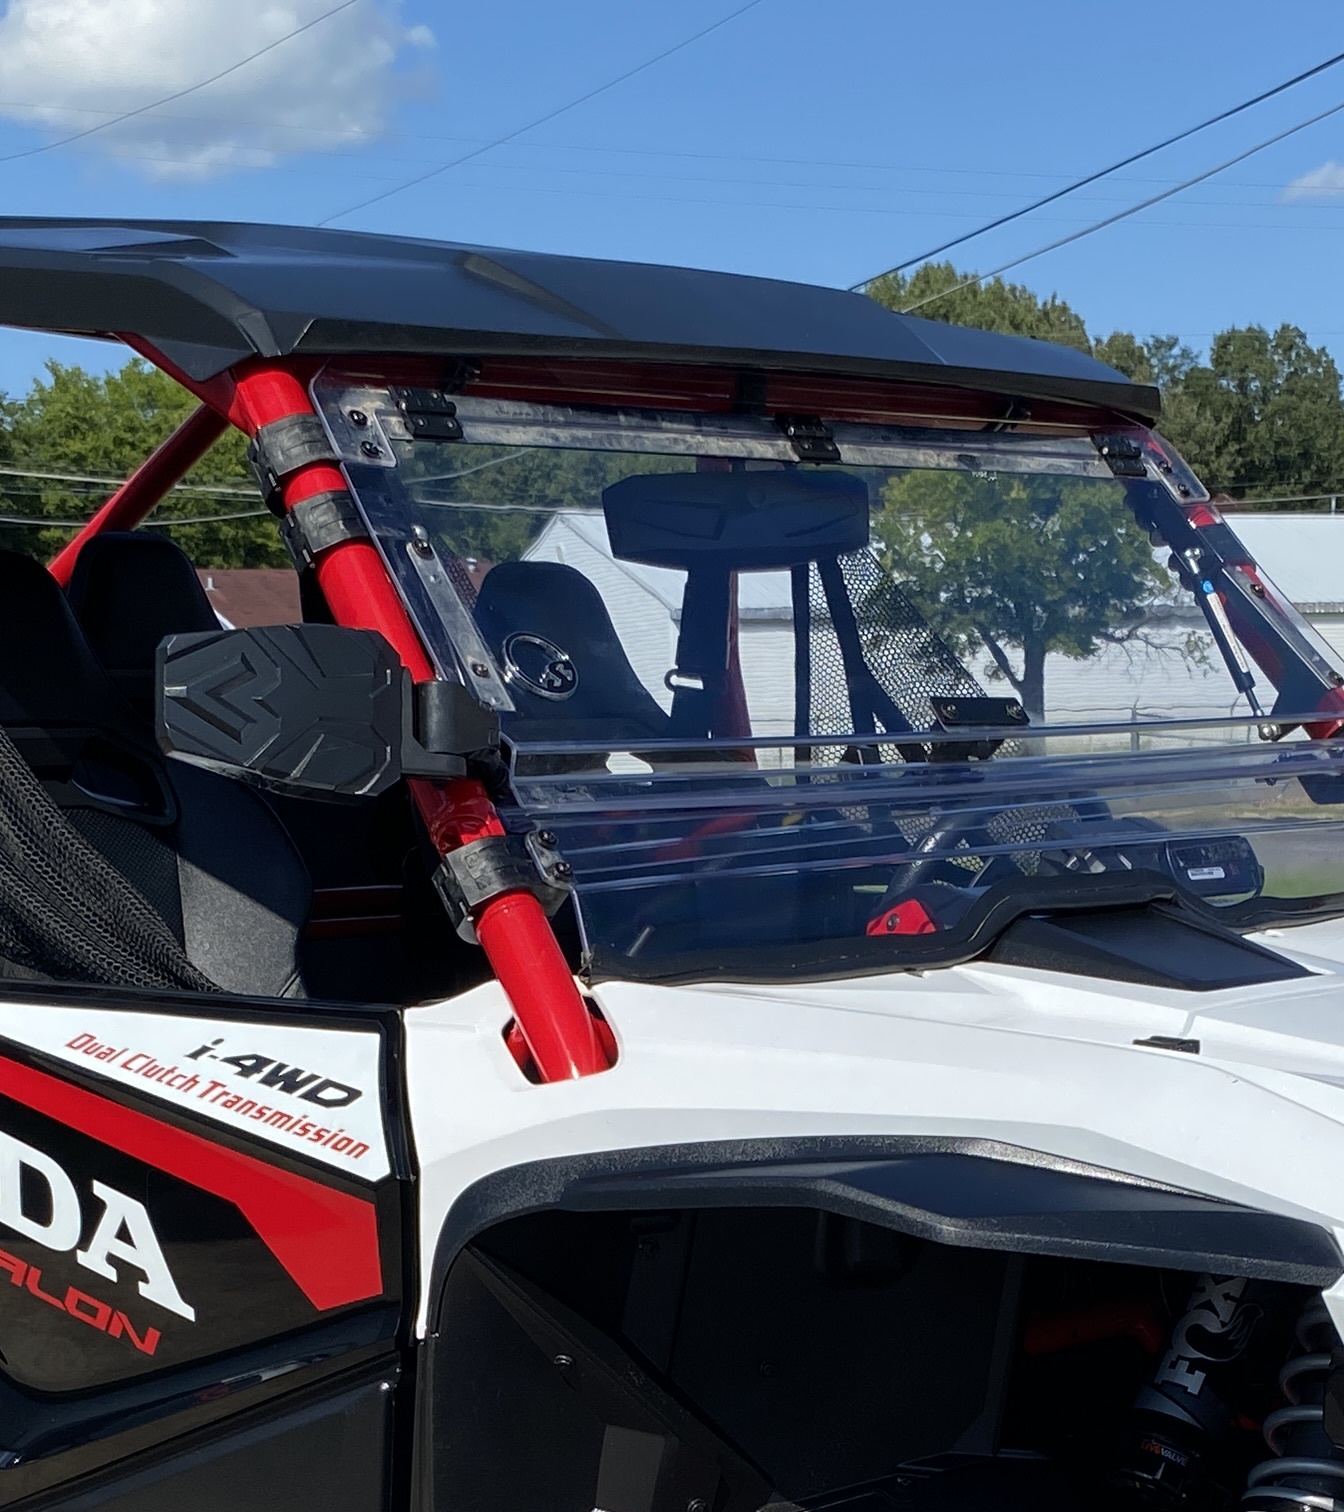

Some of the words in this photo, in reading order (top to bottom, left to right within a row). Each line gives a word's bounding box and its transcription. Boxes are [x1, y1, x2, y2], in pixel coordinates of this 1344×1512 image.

[65, 1032, 130, 1063] Dual
[120, 1052, 201, 1093] Clutch
[198, 1079, 371, 1159] Transmission
[185, 1037, 362, 1109] i-4WD
[1154, 1273, 1264, 1396] FOX
